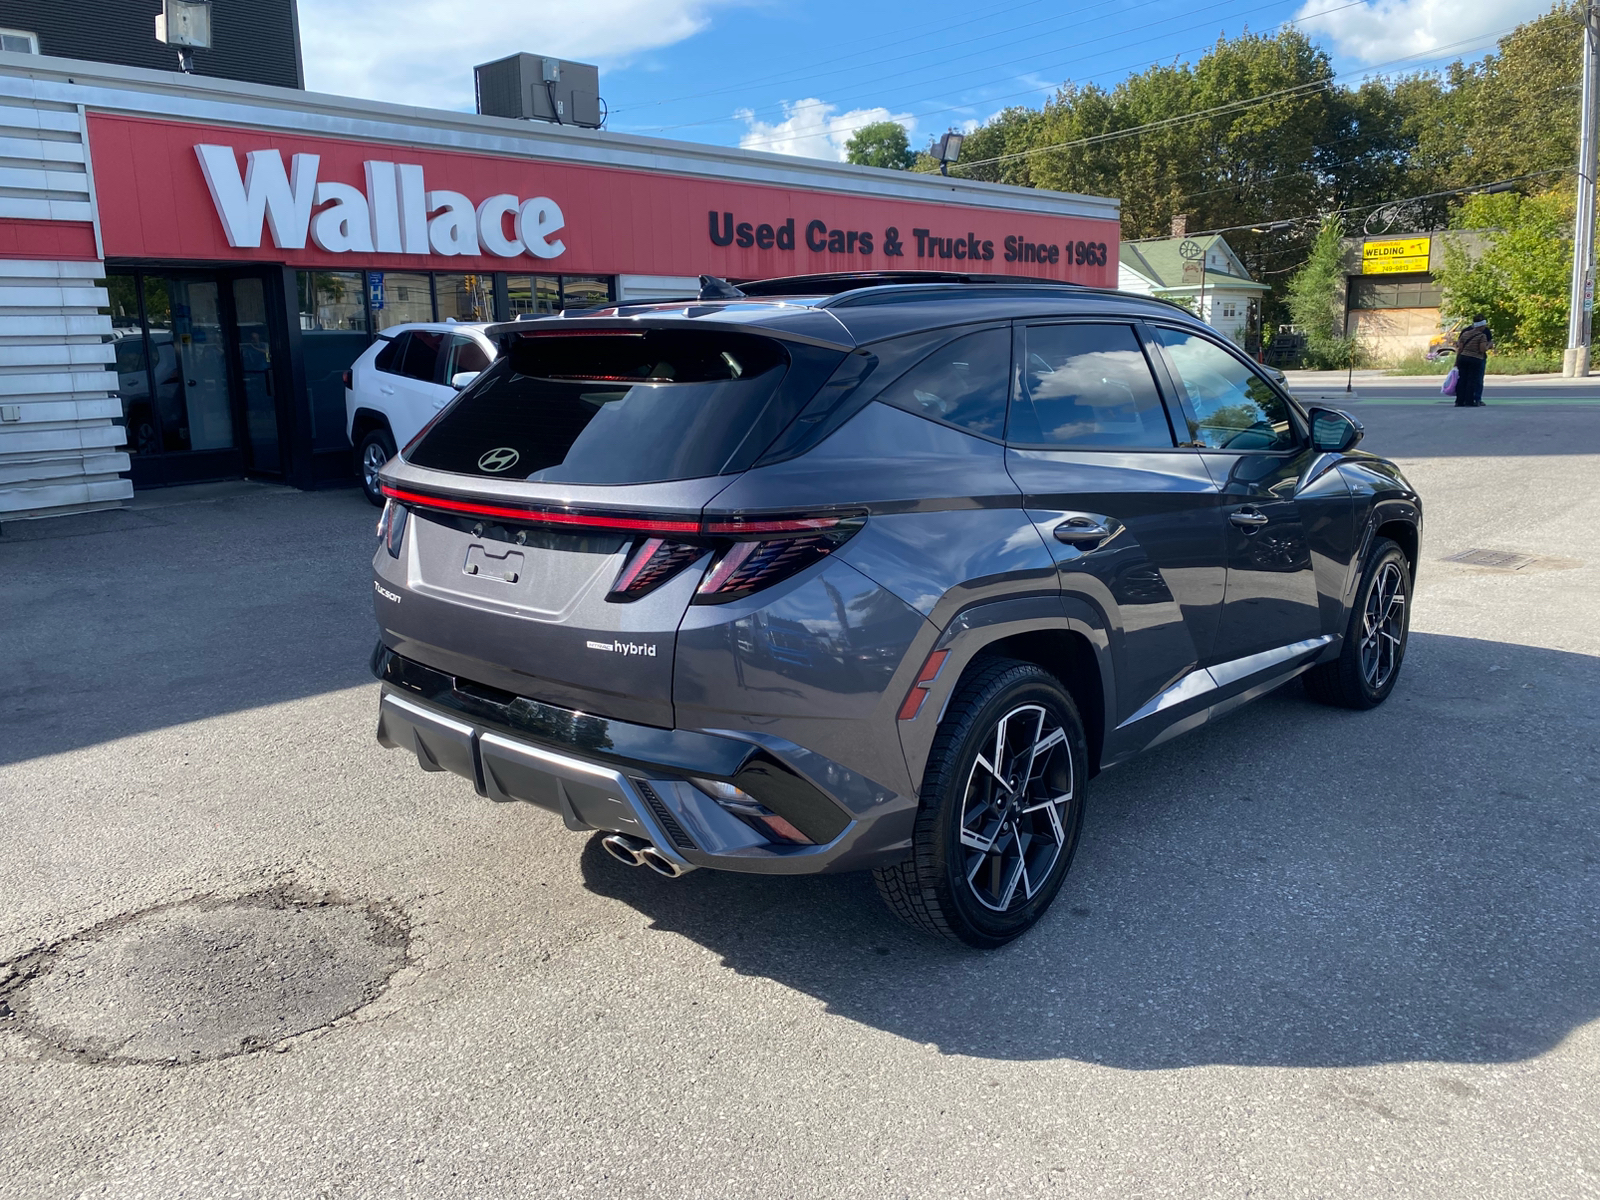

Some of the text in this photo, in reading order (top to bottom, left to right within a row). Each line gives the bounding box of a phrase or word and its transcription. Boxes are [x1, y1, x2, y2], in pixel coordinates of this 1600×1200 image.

[193, 143, 566, 259] Wallace
[708, 210, 1108, 267] Used Cars & Trucks Since 1963
[1366, 247, 1404, 256] WELDING
[614, 640, 657, 657] hybrid
